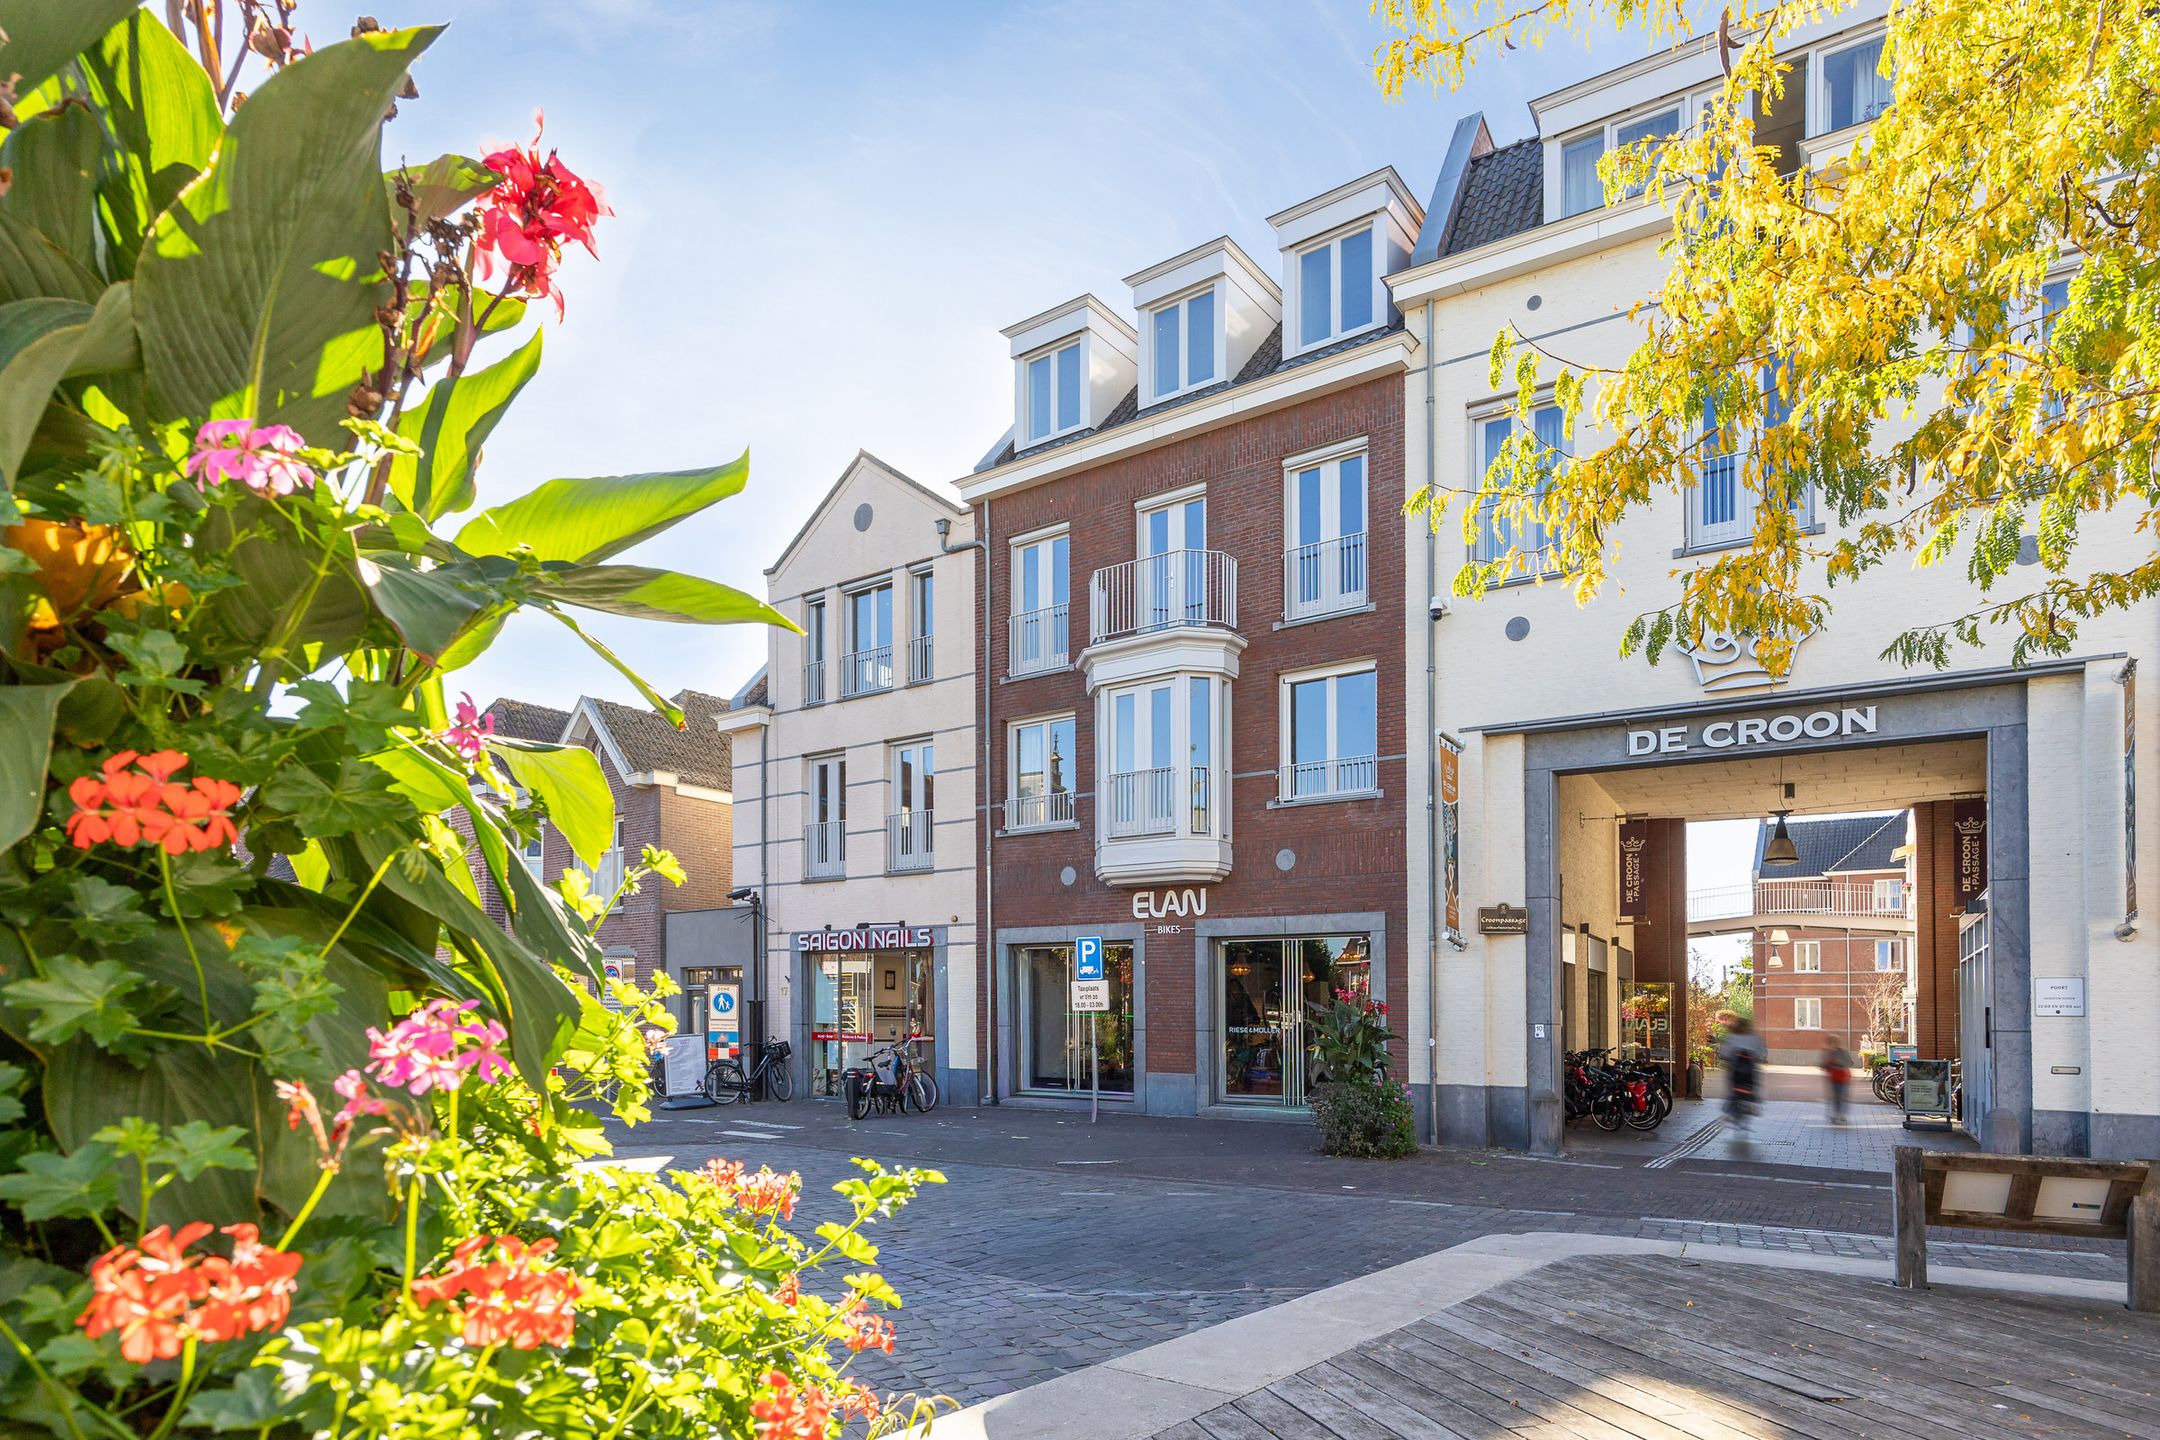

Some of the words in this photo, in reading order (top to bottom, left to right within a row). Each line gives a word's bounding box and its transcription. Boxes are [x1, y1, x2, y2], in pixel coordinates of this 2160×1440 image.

[1628, 725, 1688, 756] DE
[1702, 706, 1878, 748] CROON
[1962, 836, 1971, 874] CROON
[1972, 841, 1980, 885] PASSAGE
[1626, 889, 1633, 903] DE
[1962, 877, 1971, 892] DE
[1132, 887, 1207, 919] ELAN
[797, 931, 866, 951] SAIGON
[872, 928, 932, 948] NAILS
[1157, 925, 1181, 934] BIKES
[1081, 941, 1096, 963] P
